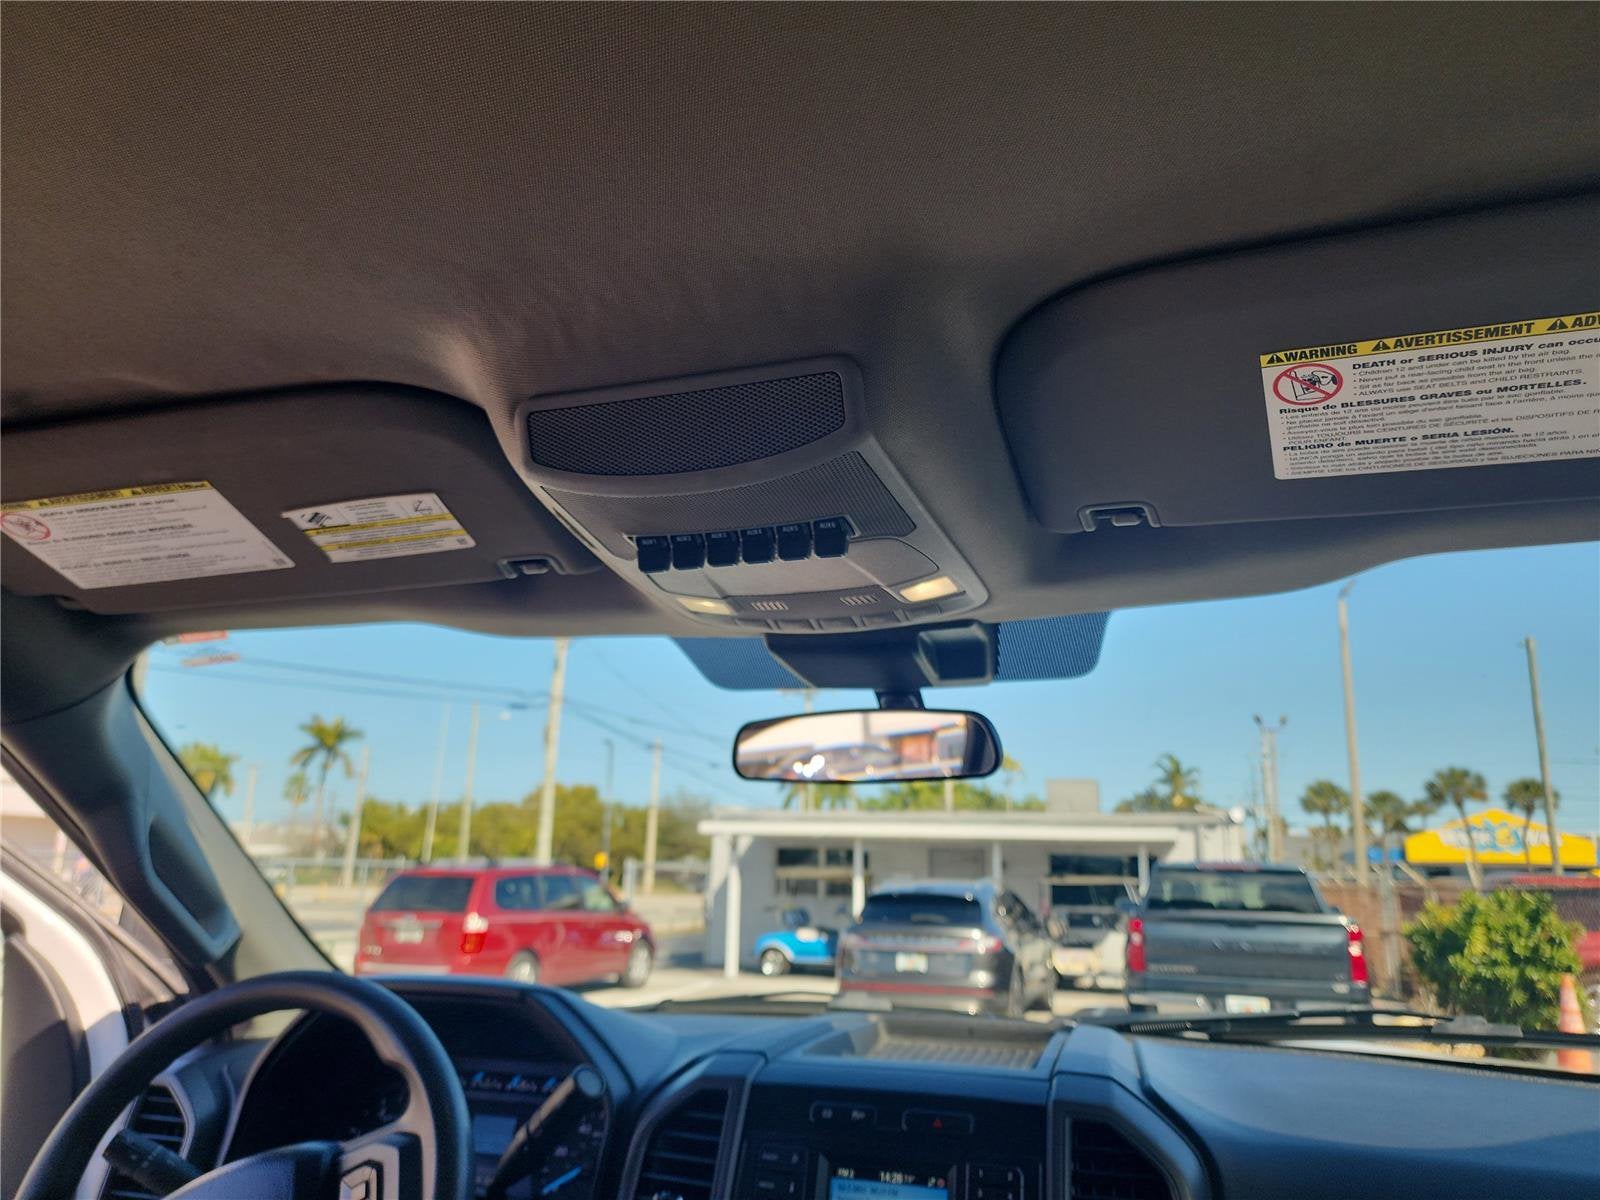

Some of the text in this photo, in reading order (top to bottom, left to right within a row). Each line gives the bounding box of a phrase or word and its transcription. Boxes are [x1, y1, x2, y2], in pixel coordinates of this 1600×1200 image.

[1392, 321, 1535, 349] AVERTISSEMENT
[1283, 343, 1357, 362] WARNING
[1352, 359, 1395, 370] DEATH
[1417, 349, 1477, 362] SERIOUS
[1482, 343, 1534, 355] INJURY
[1358, 368, 1392, 376] Children
[1279, 405, 1318, 415] Risque
[1341, 395, 1415, 408] BLESSURES
[1420, 389, 1471, 400] GRAVES
[1496, 378, 1586, 392] MORTELLES.
[1359, 388, 1393, 396] ALWAYS
[1282, 442, 1333, 451] PELIGRO
[1354, 436, 1406, 445] MUERTE
[1422, 431, 1459, 439] SERIA
[1463, 426, 1514, 436] LESIÓN.
